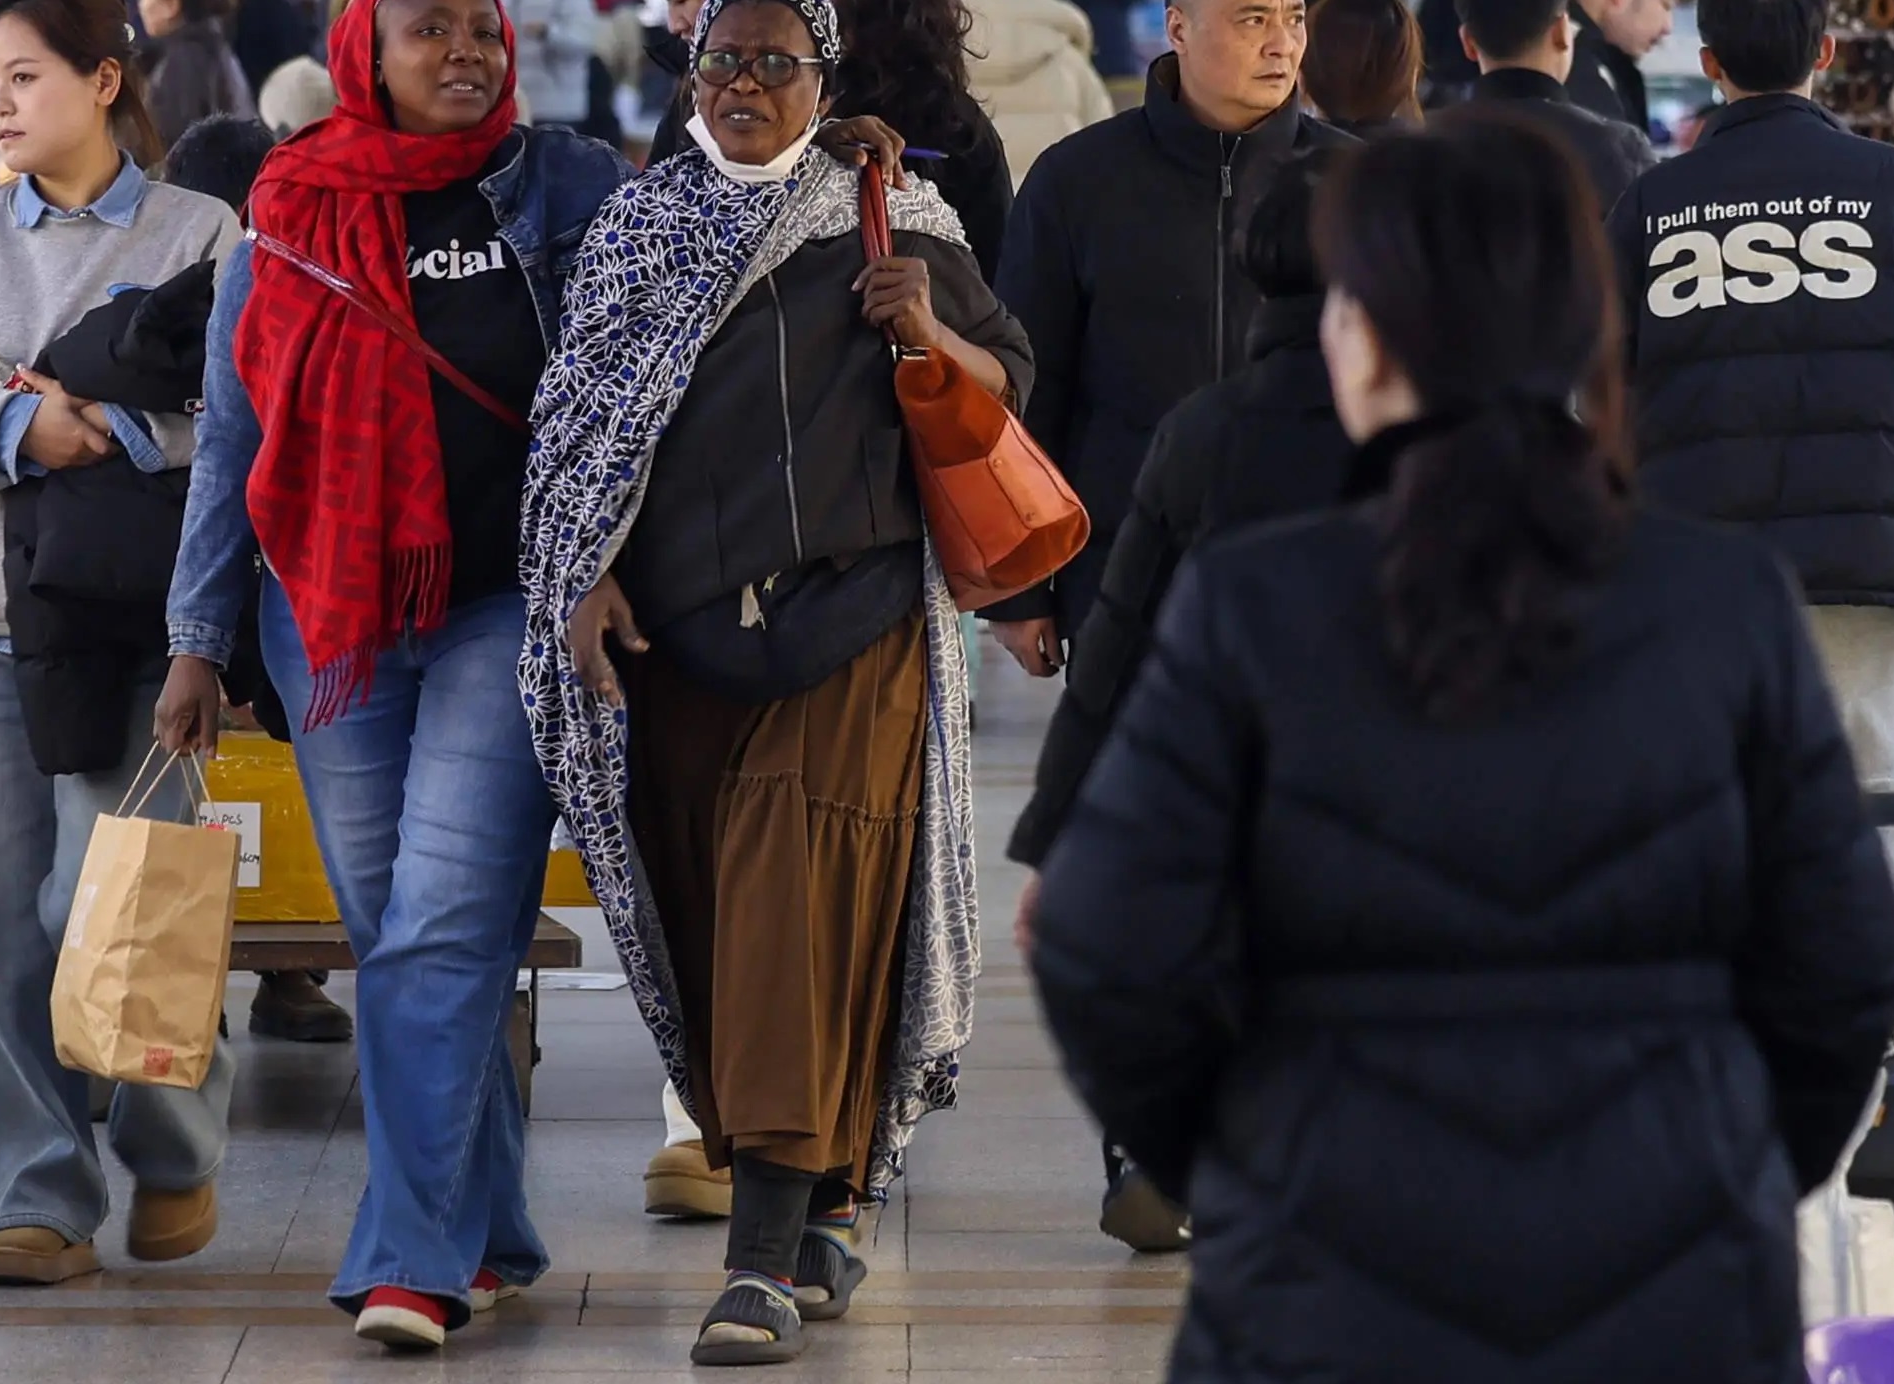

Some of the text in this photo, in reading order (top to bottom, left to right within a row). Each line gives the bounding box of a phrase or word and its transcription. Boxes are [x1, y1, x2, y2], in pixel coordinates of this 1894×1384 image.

[1657, 207, 1698, 235] pull
[1704, 202, 1759, 223] them
[1765, 197, 1804, 216] out
[1808, 195, 1833, 215] of
[1837, 200, 1872, 219] my
[1646, 220, 1878, 318] ass
